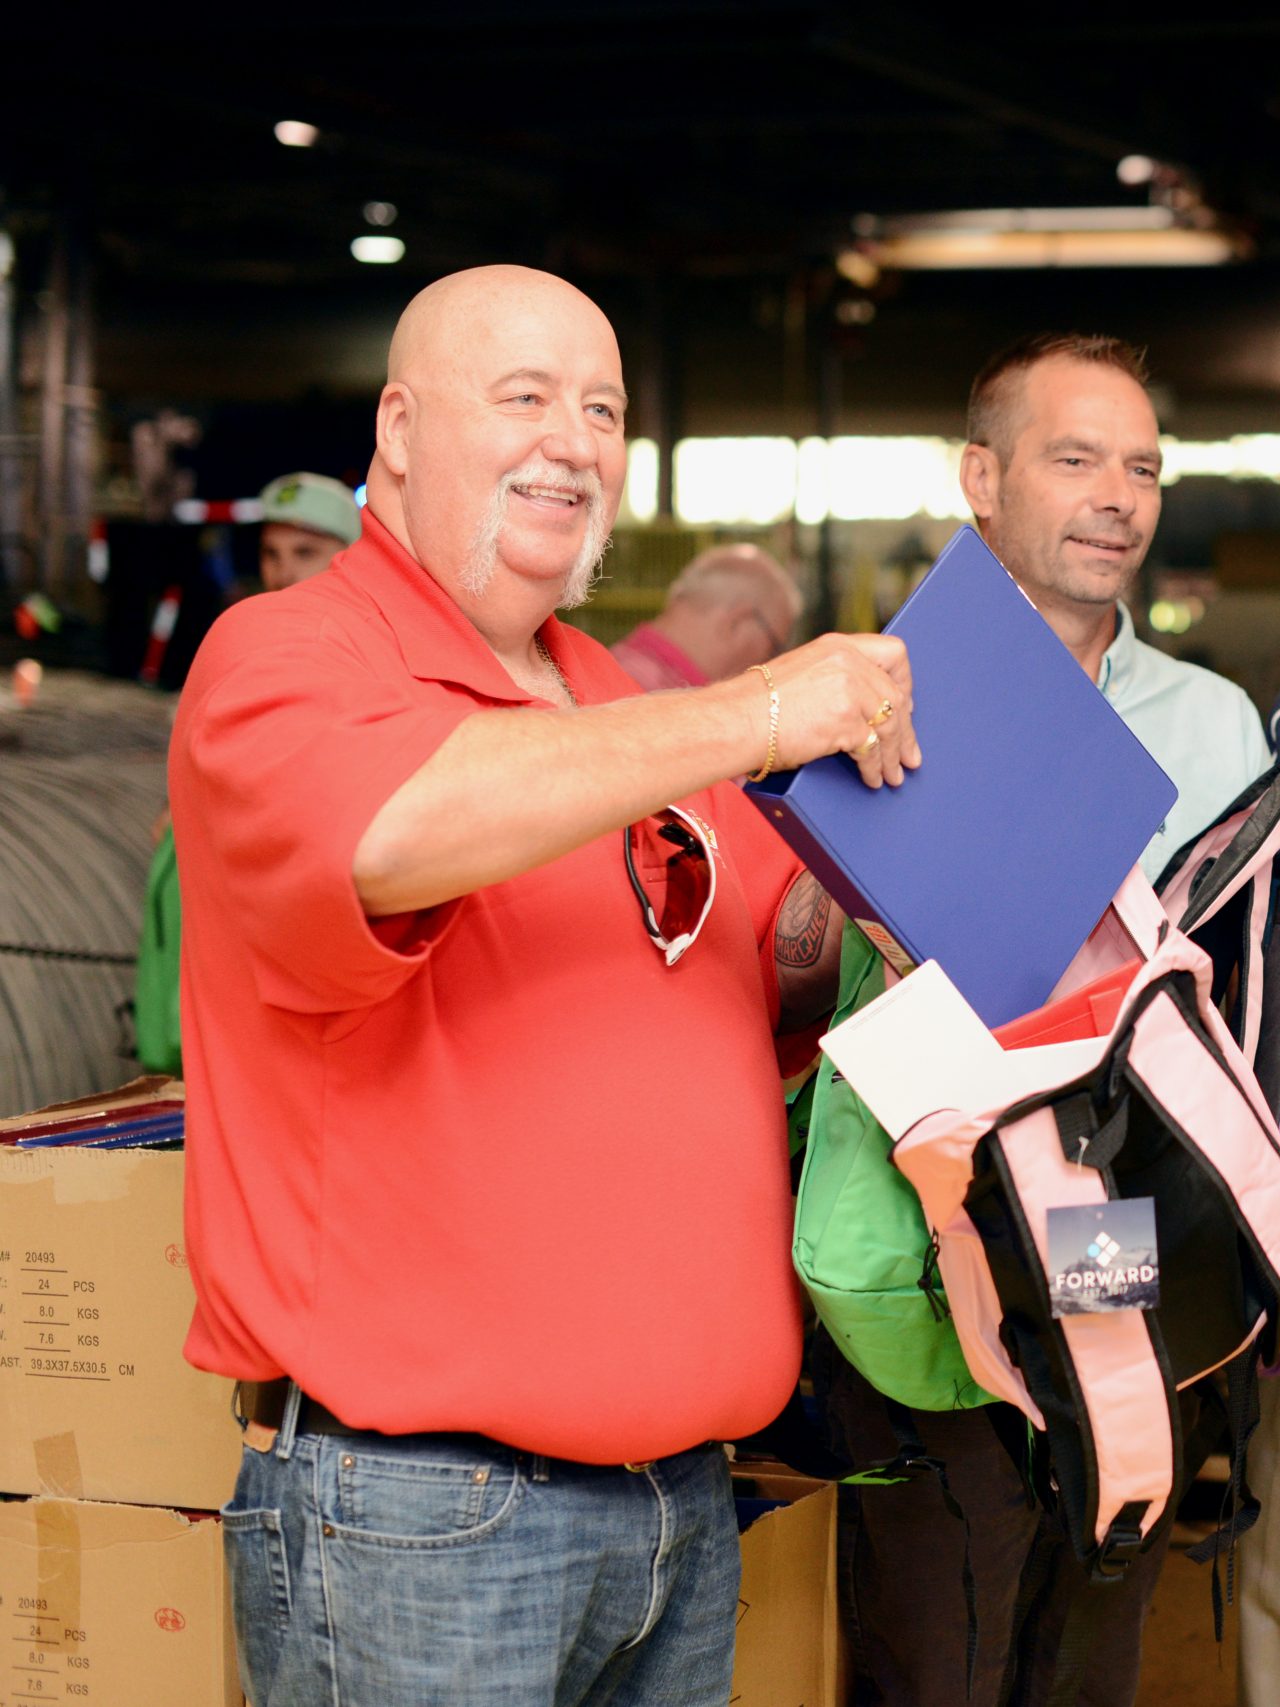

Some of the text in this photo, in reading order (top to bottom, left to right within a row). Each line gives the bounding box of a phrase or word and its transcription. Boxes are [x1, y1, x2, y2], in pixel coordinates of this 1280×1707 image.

[25, 1252, 55, 1263] 20493
[1055, 1265, 1154, 1290] FORWARD
[38, 1279, 95, 1292] 24 PCS
[39, 1306, 99, 1320] 8.0 KGS
[39, 1333, 99, 1347] 7.6 KGS
[31, 1359, 107, 1374] 39.3X37.5X30.5
[118, 1364, 135, 1376] CM
[18, 1598, 48, 1611] 20493
[30, 1625, 86, 1642] 24 PCS
[29, 1652, 90, 1669] 8.0 KGS
[66, 1683, 89, 1696] KGS
